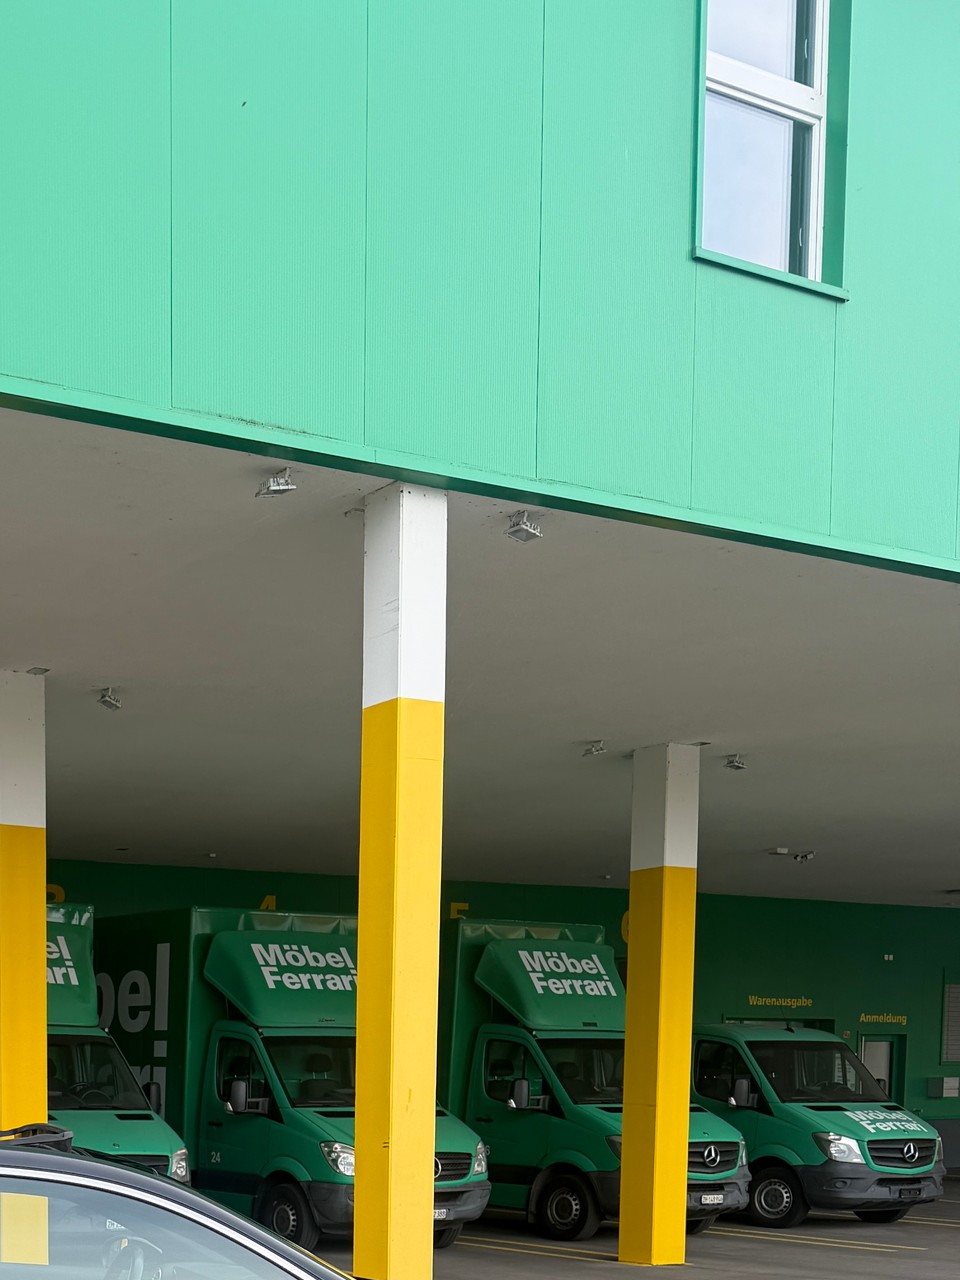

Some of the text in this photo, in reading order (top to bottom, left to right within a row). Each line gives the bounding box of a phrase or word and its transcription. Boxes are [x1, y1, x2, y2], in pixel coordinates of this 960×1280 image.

[251, 944, 355, 968] Möbel
[518, 950, 606, 974] Möbel
[528, 972, 617, 997] Ferrari
[748, 995, 813, 1008] Warenausgabe
[860, 1012, 907, 1025] Anmeldung
[844, 1110, 914, 1122] Möbel
[859, 1120, 928, 1133] Ferrari
[211, 1151, 221, 1163] 24
